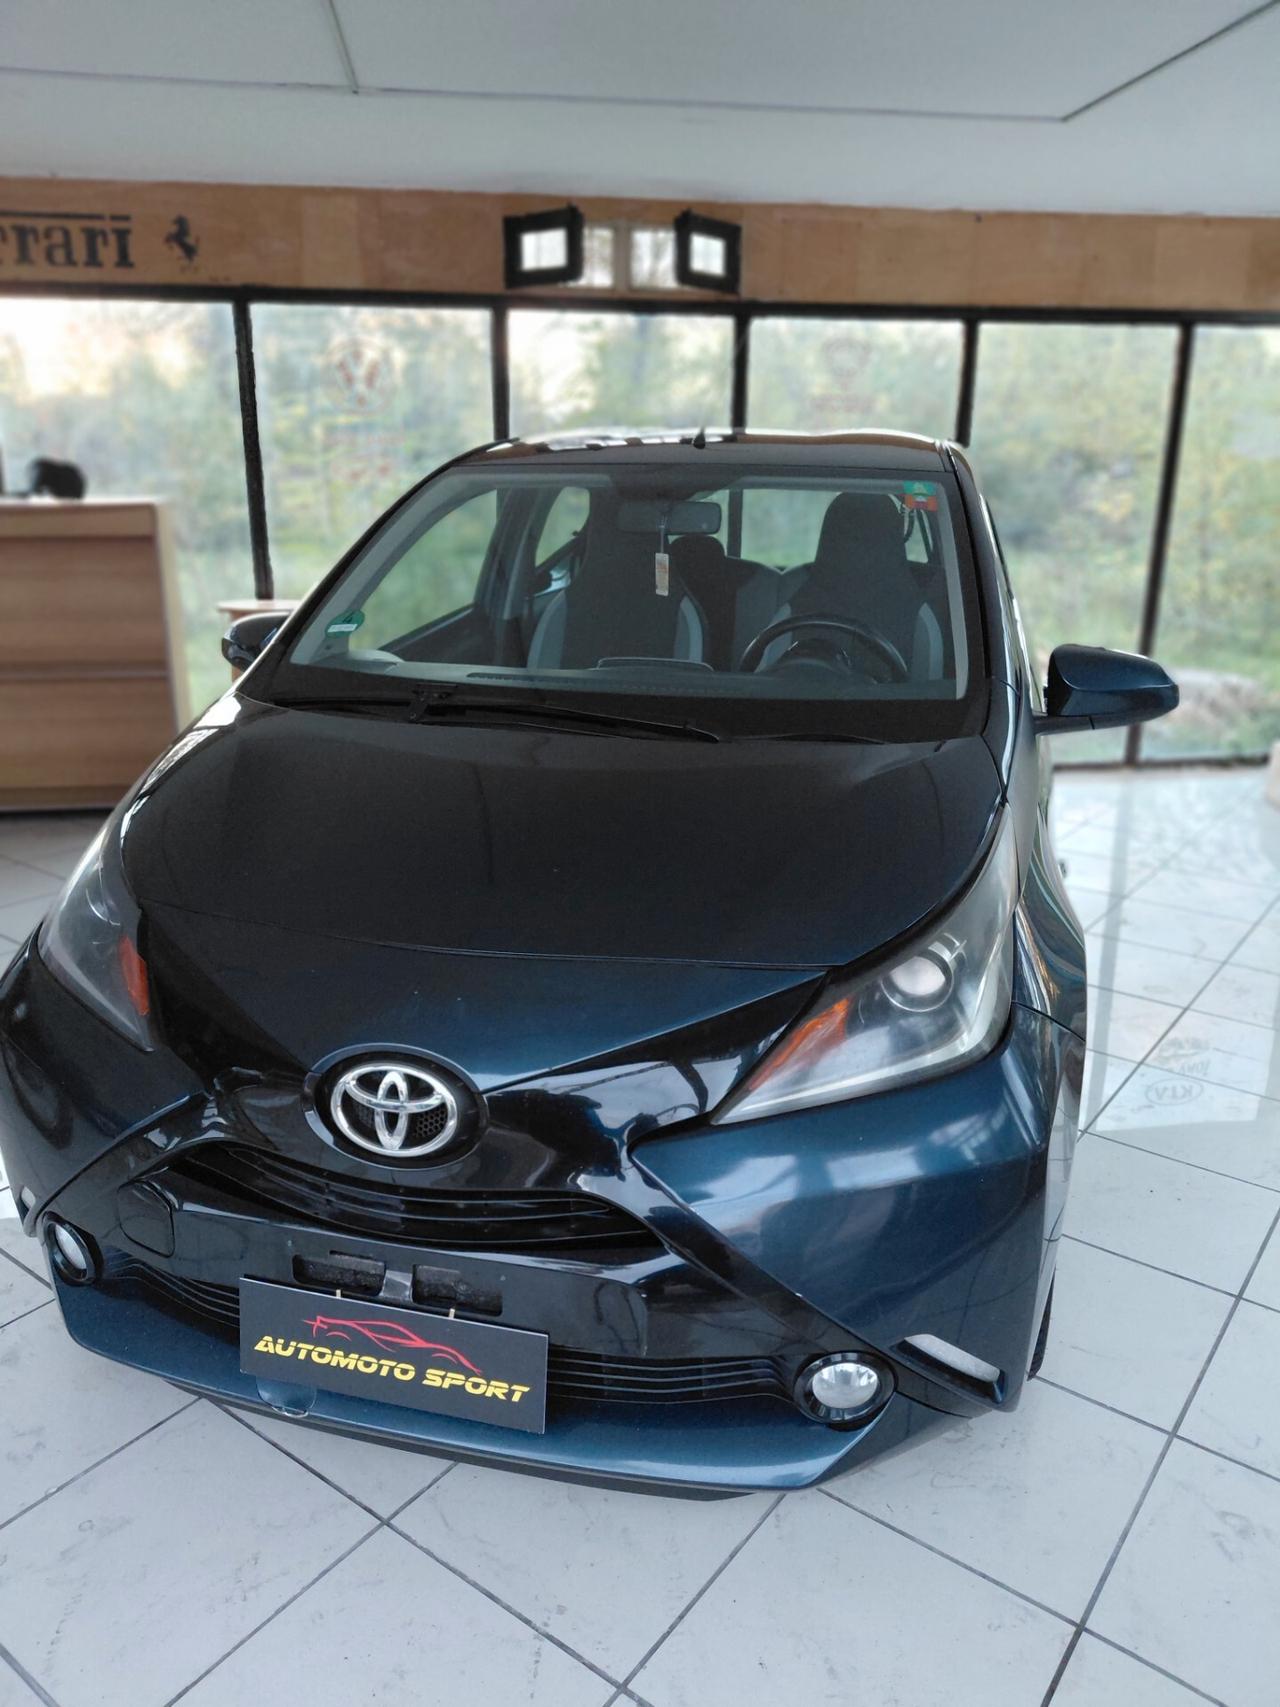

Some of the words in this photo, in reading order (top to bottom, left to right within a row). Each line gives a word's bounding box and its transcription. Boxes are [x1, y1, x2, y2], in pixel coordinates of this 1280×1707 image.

[0, 210, 134, 268] rari
[254, 1335, 415, 1382] AUTOMOTO
[422, 1368, 530, 1403] SPORT
